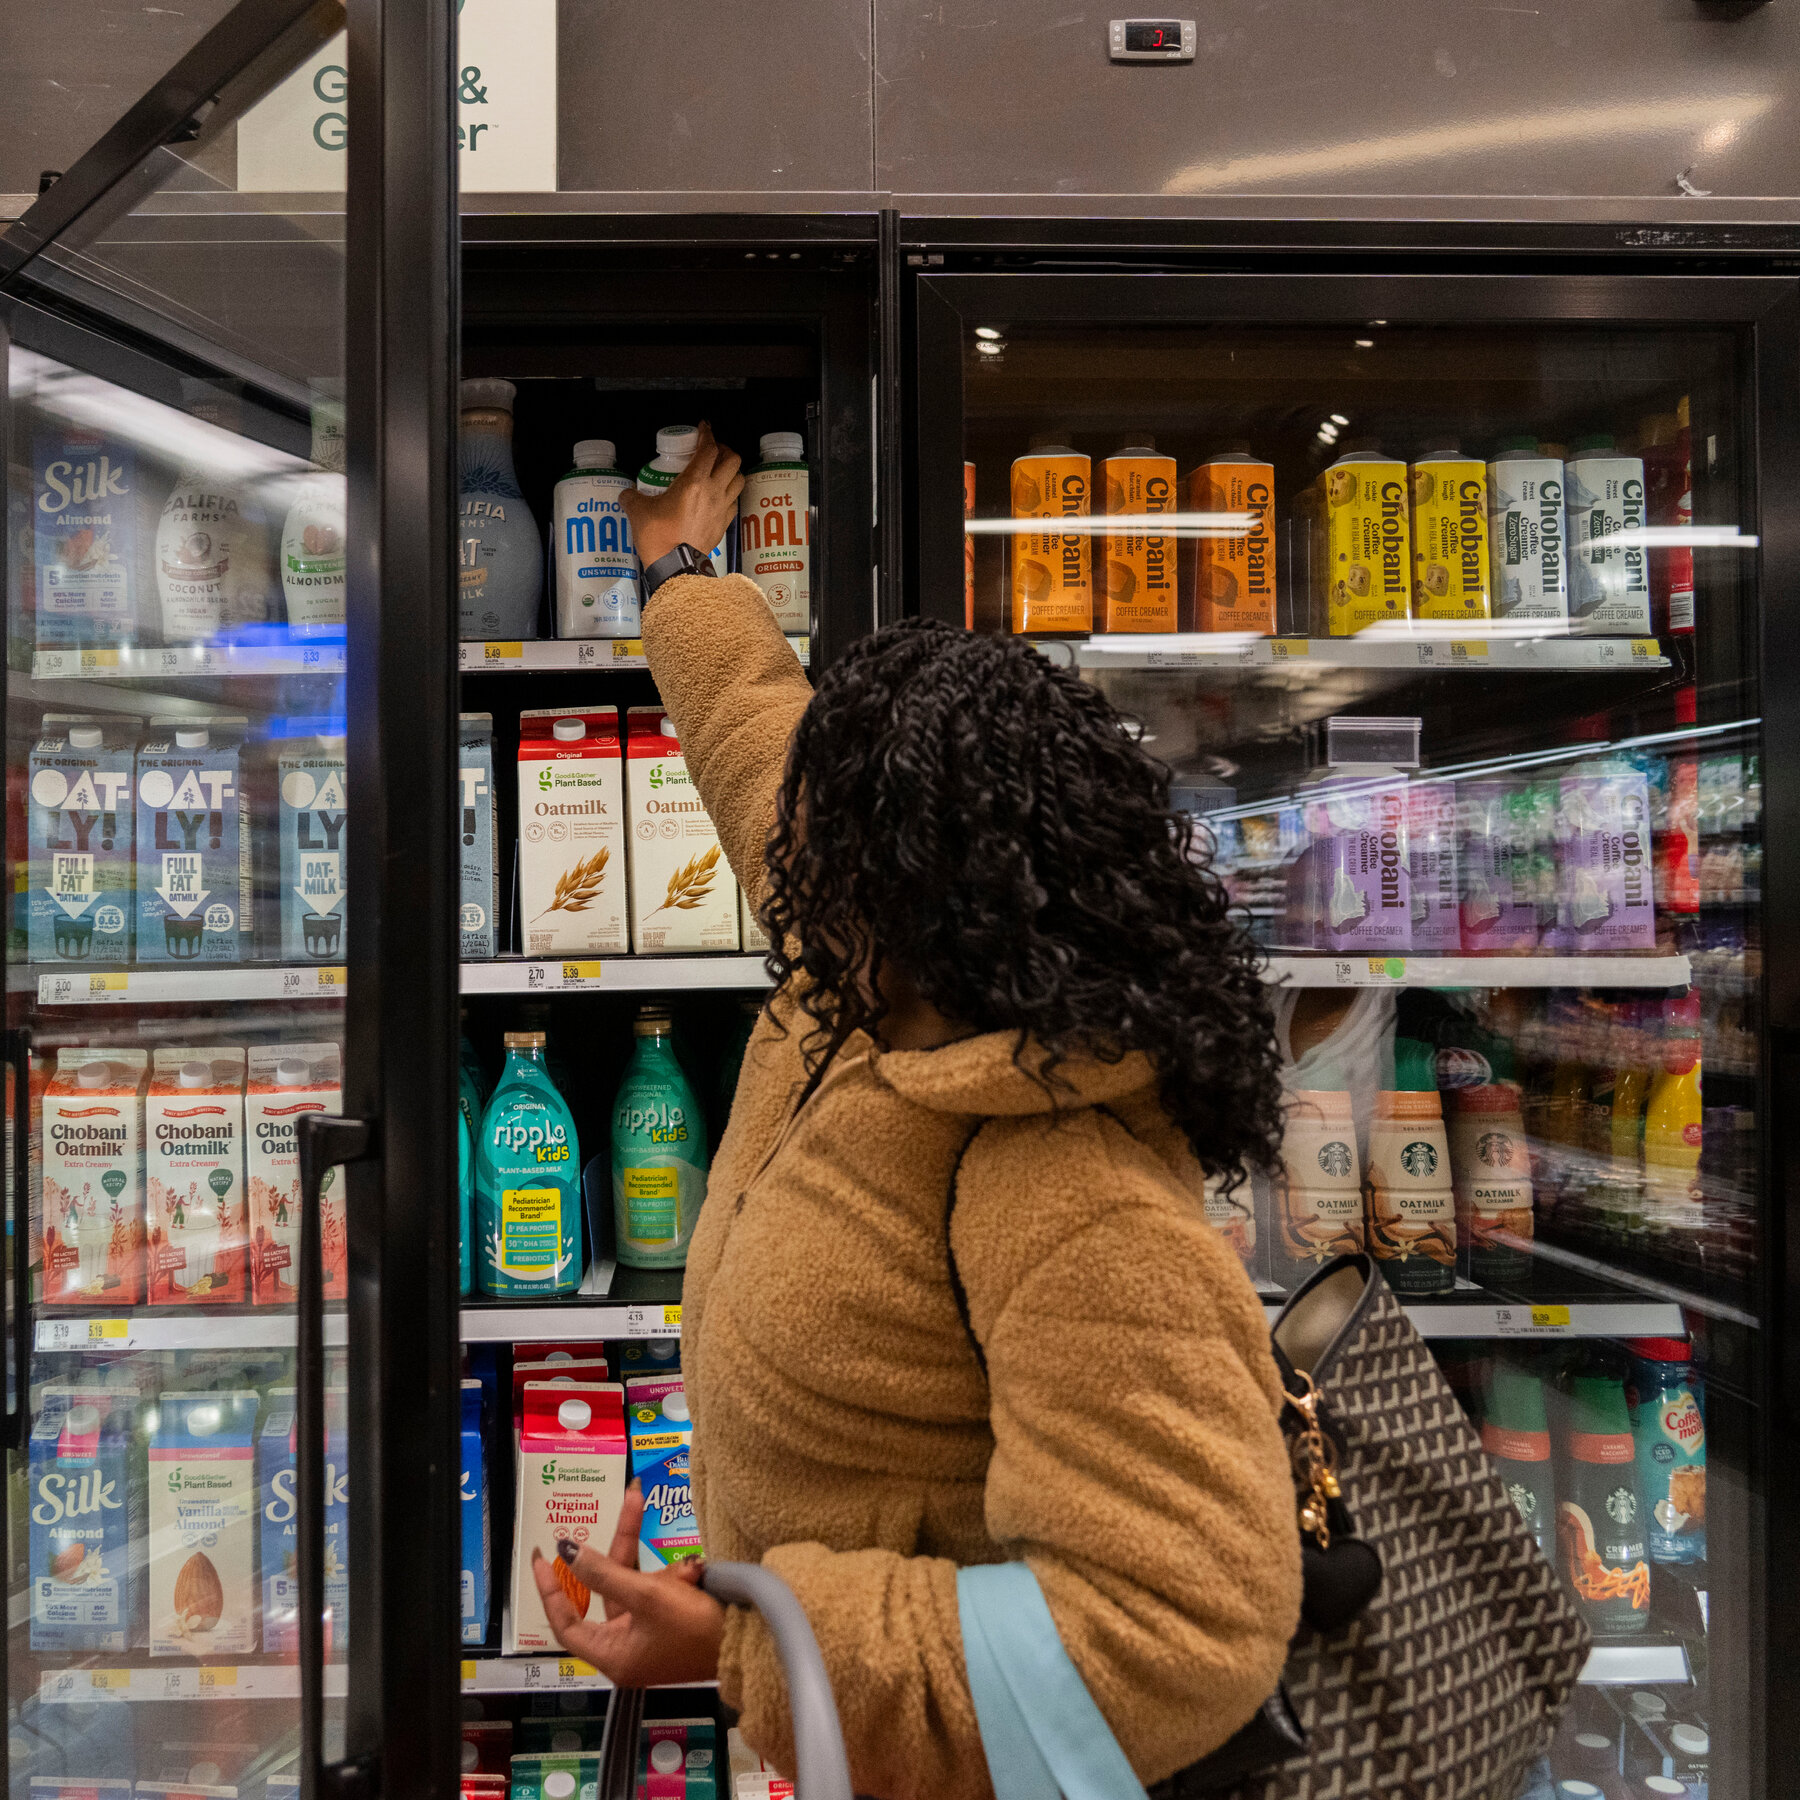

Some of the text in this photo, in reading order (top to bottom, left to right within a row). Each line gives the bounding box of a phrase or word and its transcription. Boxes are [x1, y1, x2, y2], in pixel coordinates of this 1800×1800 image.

[457, 66, 488, 104] &
[39, 456, 130, 513] Silk
[760, 493, 793, 508] oat
[57, 514, 112, 524] Almond
[173, 514, 219, 522] FARMS
[1363, 517, 1371, 560] Creamer
[1371, 522, 1381, 555] Coffee
[1381, 481, 1406, 593] Chobani
[1440, 516, 1449, 560] Creamer
[1449, 522, 1458, 554] Coffee
[1459, 481, 1485, 592] Chobani
[1521, 517, 1529, 561] Creamer
[1529, 522, 1538, 555] Coffee
[1540, 481, 1565, 593] Chobani
[758, 563, 800, 572] ORIGINAL
[169, 583, 220, 593] COCONUT
[611, 595, 618, 604] 3
[776, 590, 783, 600] 3
[1032, 606, 1085, 615] COFFEE CREAMER
[1116, 607, 1168, 616] COFFEE CREAMER
[1355, 610, 1405, 620] COFFEE CREAMER
[1433, 610, 1484, 619] COFFEE CREAMER
[1593, 610, 1643, 620] COFFEE CREAMER
[1219, 611, 1269, 622] COFFEE CREAMER
[485, 649, 500, 658] 5.49
[579, 647, 594, 657] 8.45
[613, 647, 628, 656] 7.39
[1272, 646, 1287, 655] 5.99
[1417, 646, 1433, 656] 7.99
[1632, 646, 1647, 655] 5.99
[32, 758, 98, 767] THE ORIGINAL
[140, 759, 204, 767] THE ORIGINAL
[281, 760, 345, 768] THE ORIGINAL
[555, 778, 602, 787] Plant Based
[666, 777, 687, 785] Plant
[534, 800, 607, 817] Oatmilk
[47, 811, 116, 851] LY!
[156, 811, 223, 850] LY!
[1361, 831, 1369, 874] Creamer
[1369, 836, 1378, 869] Coffee
[1381, 796, 1404, 908] Chobani
[1621, 795, 1648, 908] Chobani
[58, 858, 88, 875] FULL
[167, 858, 197, 875] FULL
[306, 862, 333, 878] OAT-
[61, 875, 85, 892] FAT
[170, 875, 193, 891] FAT
[304, 878, 336, 895] MILK
[169, 893, 198, 902] OATMILK
[98, 915, 121, 926] 0.63
[208, 914, 230, 924] 0.63
[1351, 926, 1403, 936] COFFEE CREAMER
[1594, 925, 1648, 935] COFFEE CREAMER
[529, 969, 544, 979] 2.70
[563, 968, 578, 978] 5.39
[1336, 964, 1350, 974] 7.99
[1369, 964, 1384, 974] 5.99
[284, 976, 299, 985] 3.00
[318, 974, 334, 984] 5.99
[55, 981, 71, 991] 3.00
[90, 981, 105, 990] 5.99
[618, 1103, 684, 1135] ripple
[51, 1124, 128, 1140] Chobani
[155, 1123, 235, 1139] Chobani
[494, 1120, 566, 1153] ripple
[652, 1128, 688, 1144] Kids
[55, 1141, 125, 1156] Oatmilk
[160, 1141, 231, 1155] Oatmilk
[537, 1145, 569, 1163] Kids
[64, 1160, 112, 1169] Extra Creamy
[170, 1160, 219, 1168] Extra Creamy
[1475, 1189, 1521, 1198] OATMILK
[1317, 1200, 1358, 1209] OATMILK
[1400, 1200, 1445, 1208] OATMILK
[635, 1438, 655, 1447] 50%
[558, 1474, 605, 1482] Plant Based
[184, 1481, 206, 1489] Plant
[32, 1469, 122, 1525] Silk
[177, 1506, 221, 1517] Vanilla
[546, 1499, 599, 1513] Original
[173, 1518, 225, 1530] Almond
[546, 1513, 598, 1524] Almond
[49, 1528, 104, 1539] Almond
[41, 1583, 52, 1597] 5
[276, 1581, 287, 1596] 5
[525, 1666, 540, 1677] 1.65
[559, 1666, 574, 1676] 3.29
